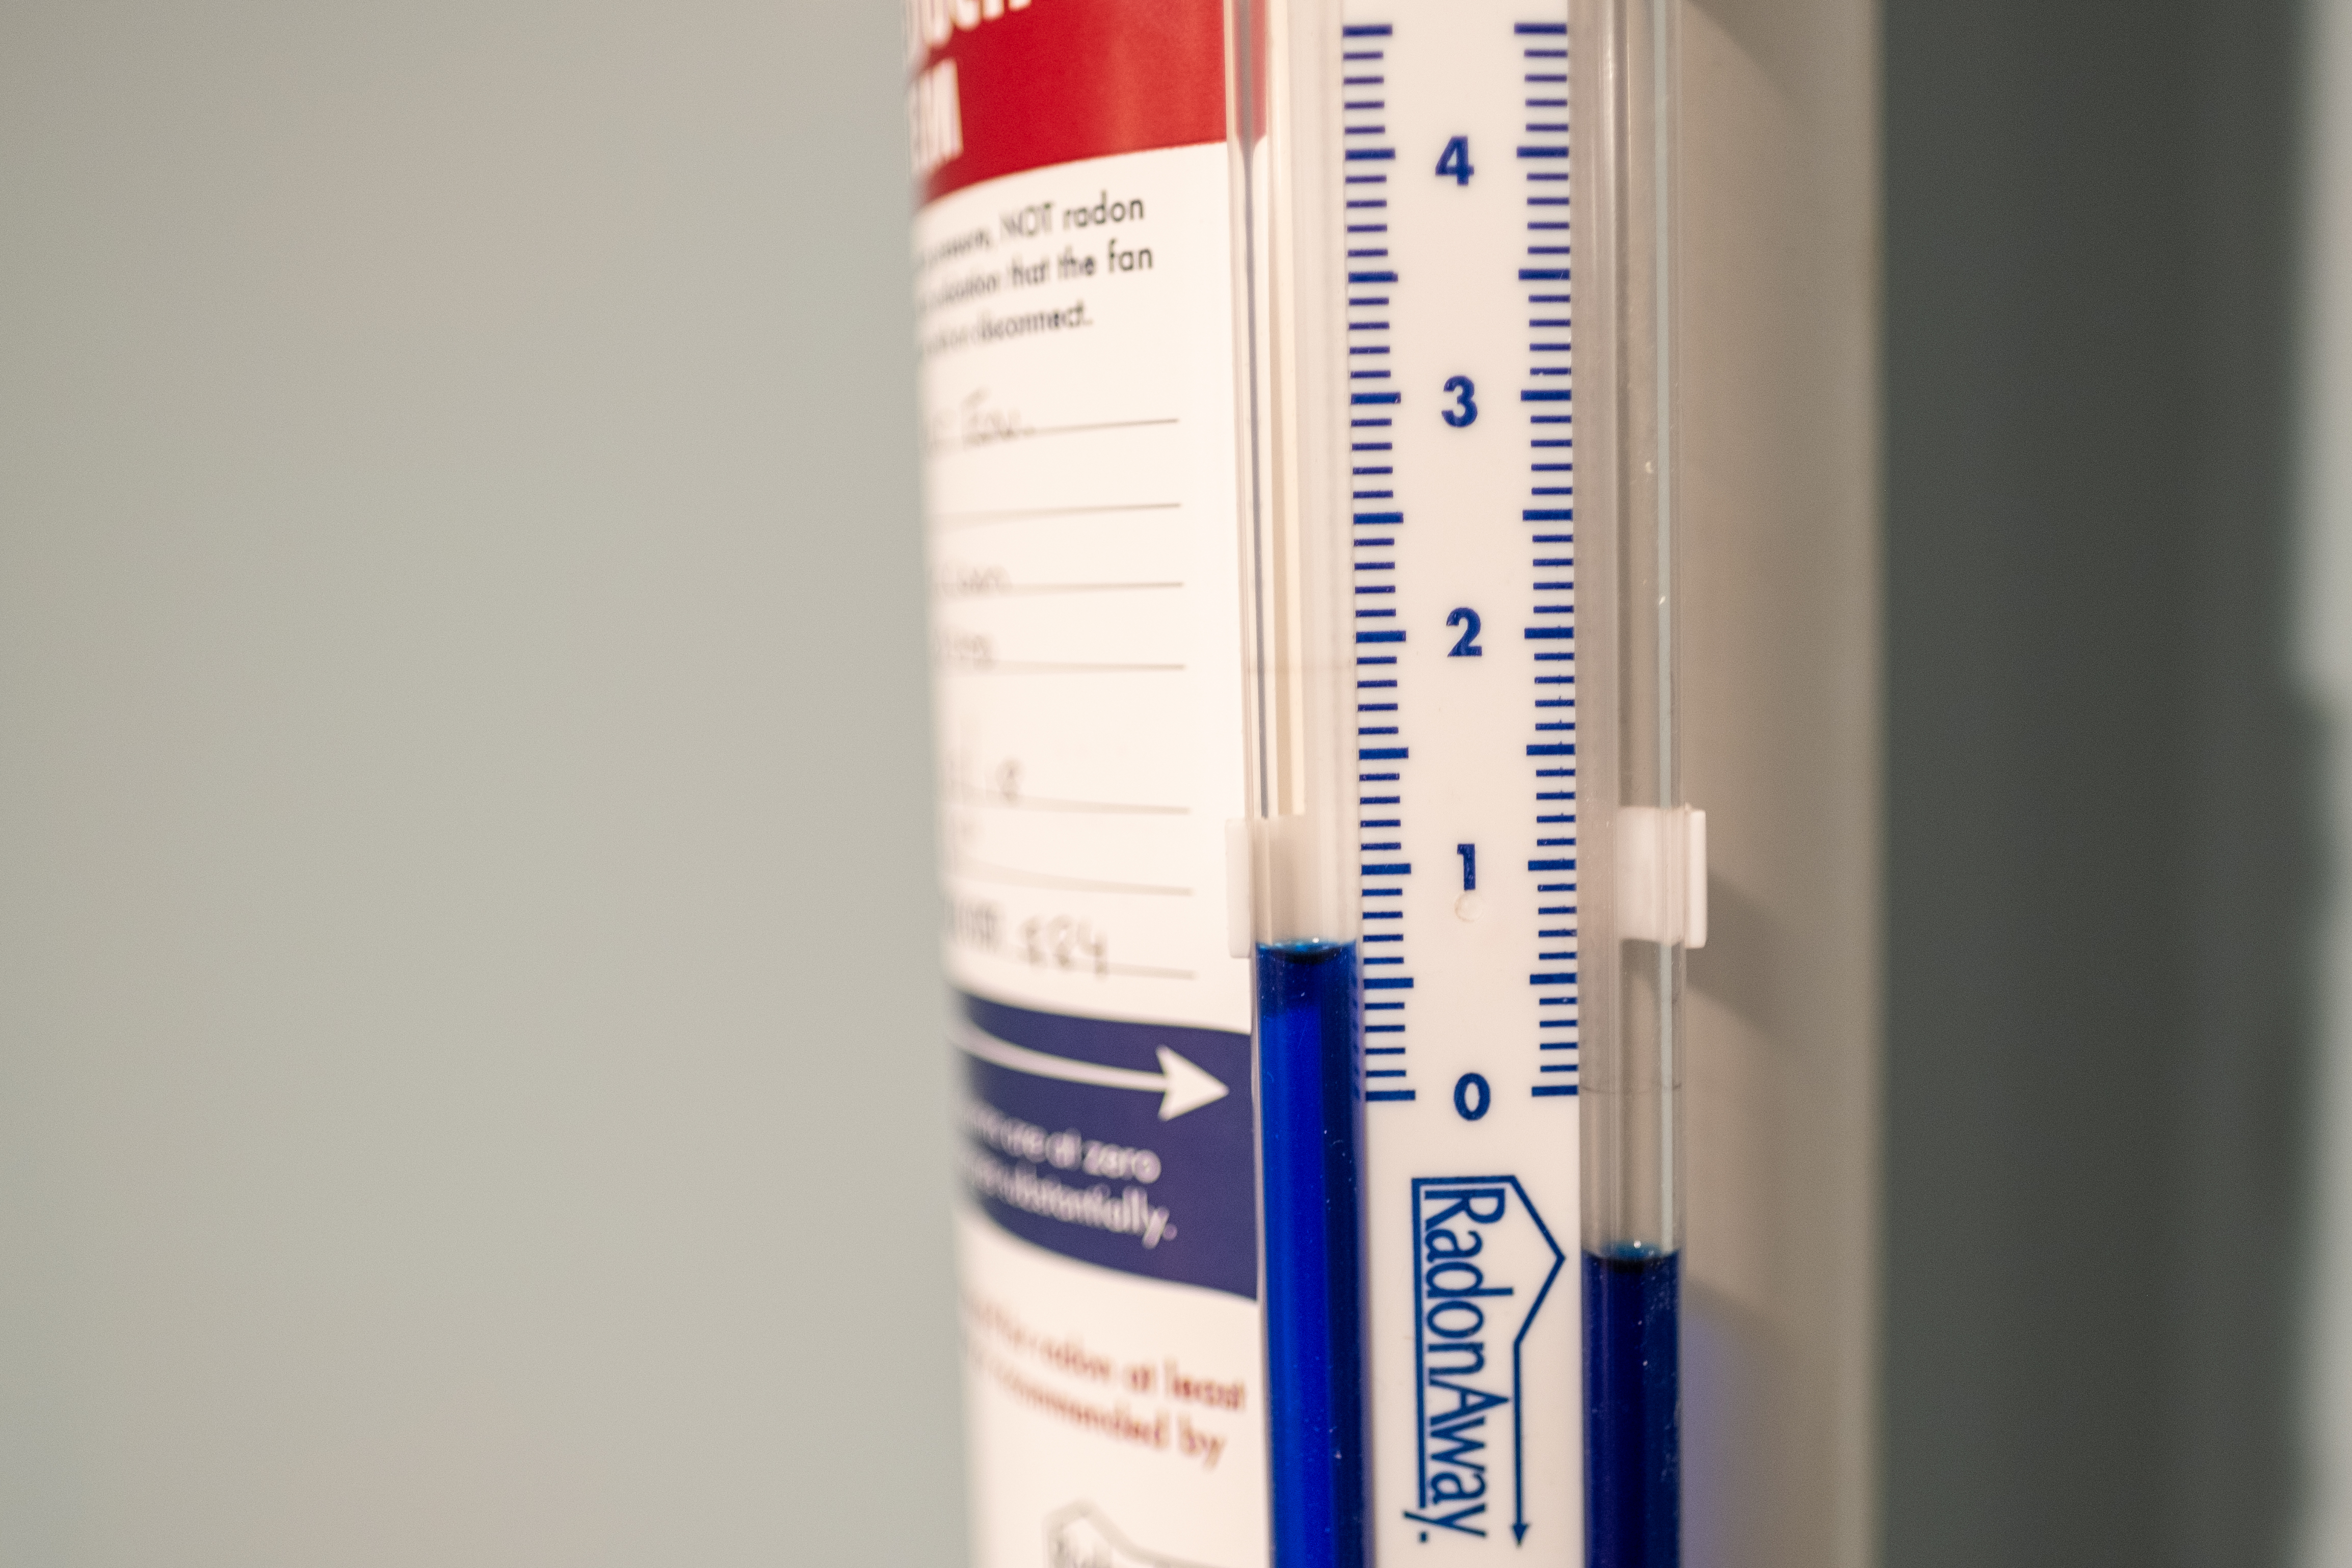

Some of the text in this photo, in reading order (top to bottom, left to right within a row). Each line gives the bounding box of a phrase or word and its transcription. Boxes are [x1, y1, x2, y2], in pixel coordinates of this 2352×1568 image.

[1436, 138, 1473, 185] 4
[1063, 190, 1145, 230] radon
[1058, 246, 1096, 280] the
[1107, 238, 1154, 274] fan
[1443, 376, 1478, 428] 3
[1447, 607, 1482, 657] 2
[1457, 844, 1475, 890] 1
[1454, 1073, 1491, 1121] 0
[1083, 1140, 1161, 1183] zero
[1177, 1409, 1227, 1470] by
